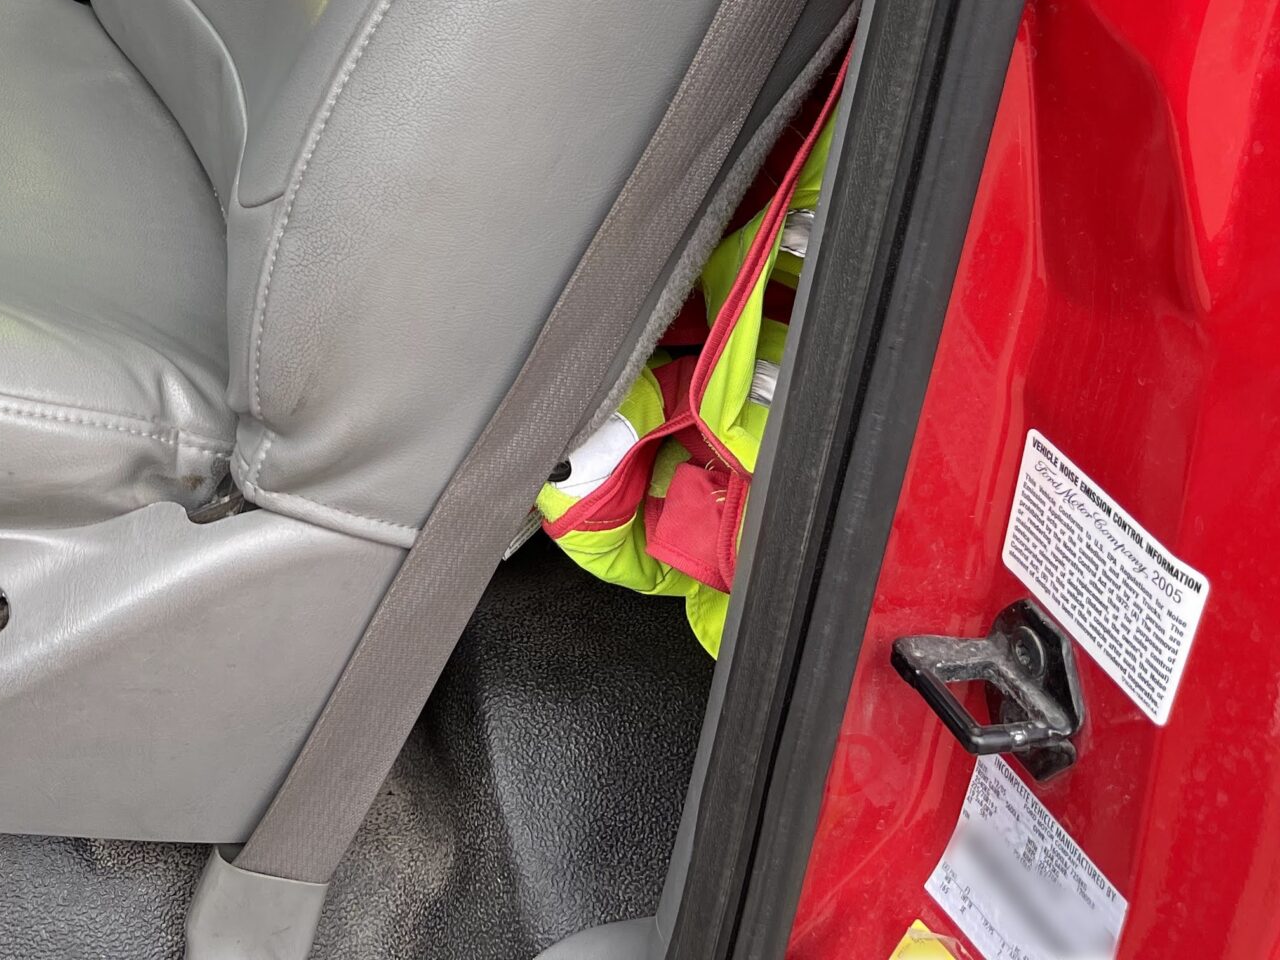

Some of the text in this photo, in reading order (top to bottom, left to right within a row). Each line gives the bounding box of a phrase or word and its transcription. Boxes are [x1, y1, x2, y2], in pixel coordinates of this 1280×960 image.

[1032, 436, 1202, 594] VEHICLE NOISE EMISSION CONTROL INFORMATION
[1034, 460, 1062, 494] Ford
[1054, 482, 1094, 518] Motor
[1150, 569, 1182, 603] 2005
[994, 757, 1030, 803] INCOMPLETE
[1030, 798, 1055, 833] VEHICLE
[1055, 826, 1105, 890] MANUFACTURED
[1105, 886, 1117, 902] BY
[1023, 802, 1079, 869] FORD MOTOR COMPANY
